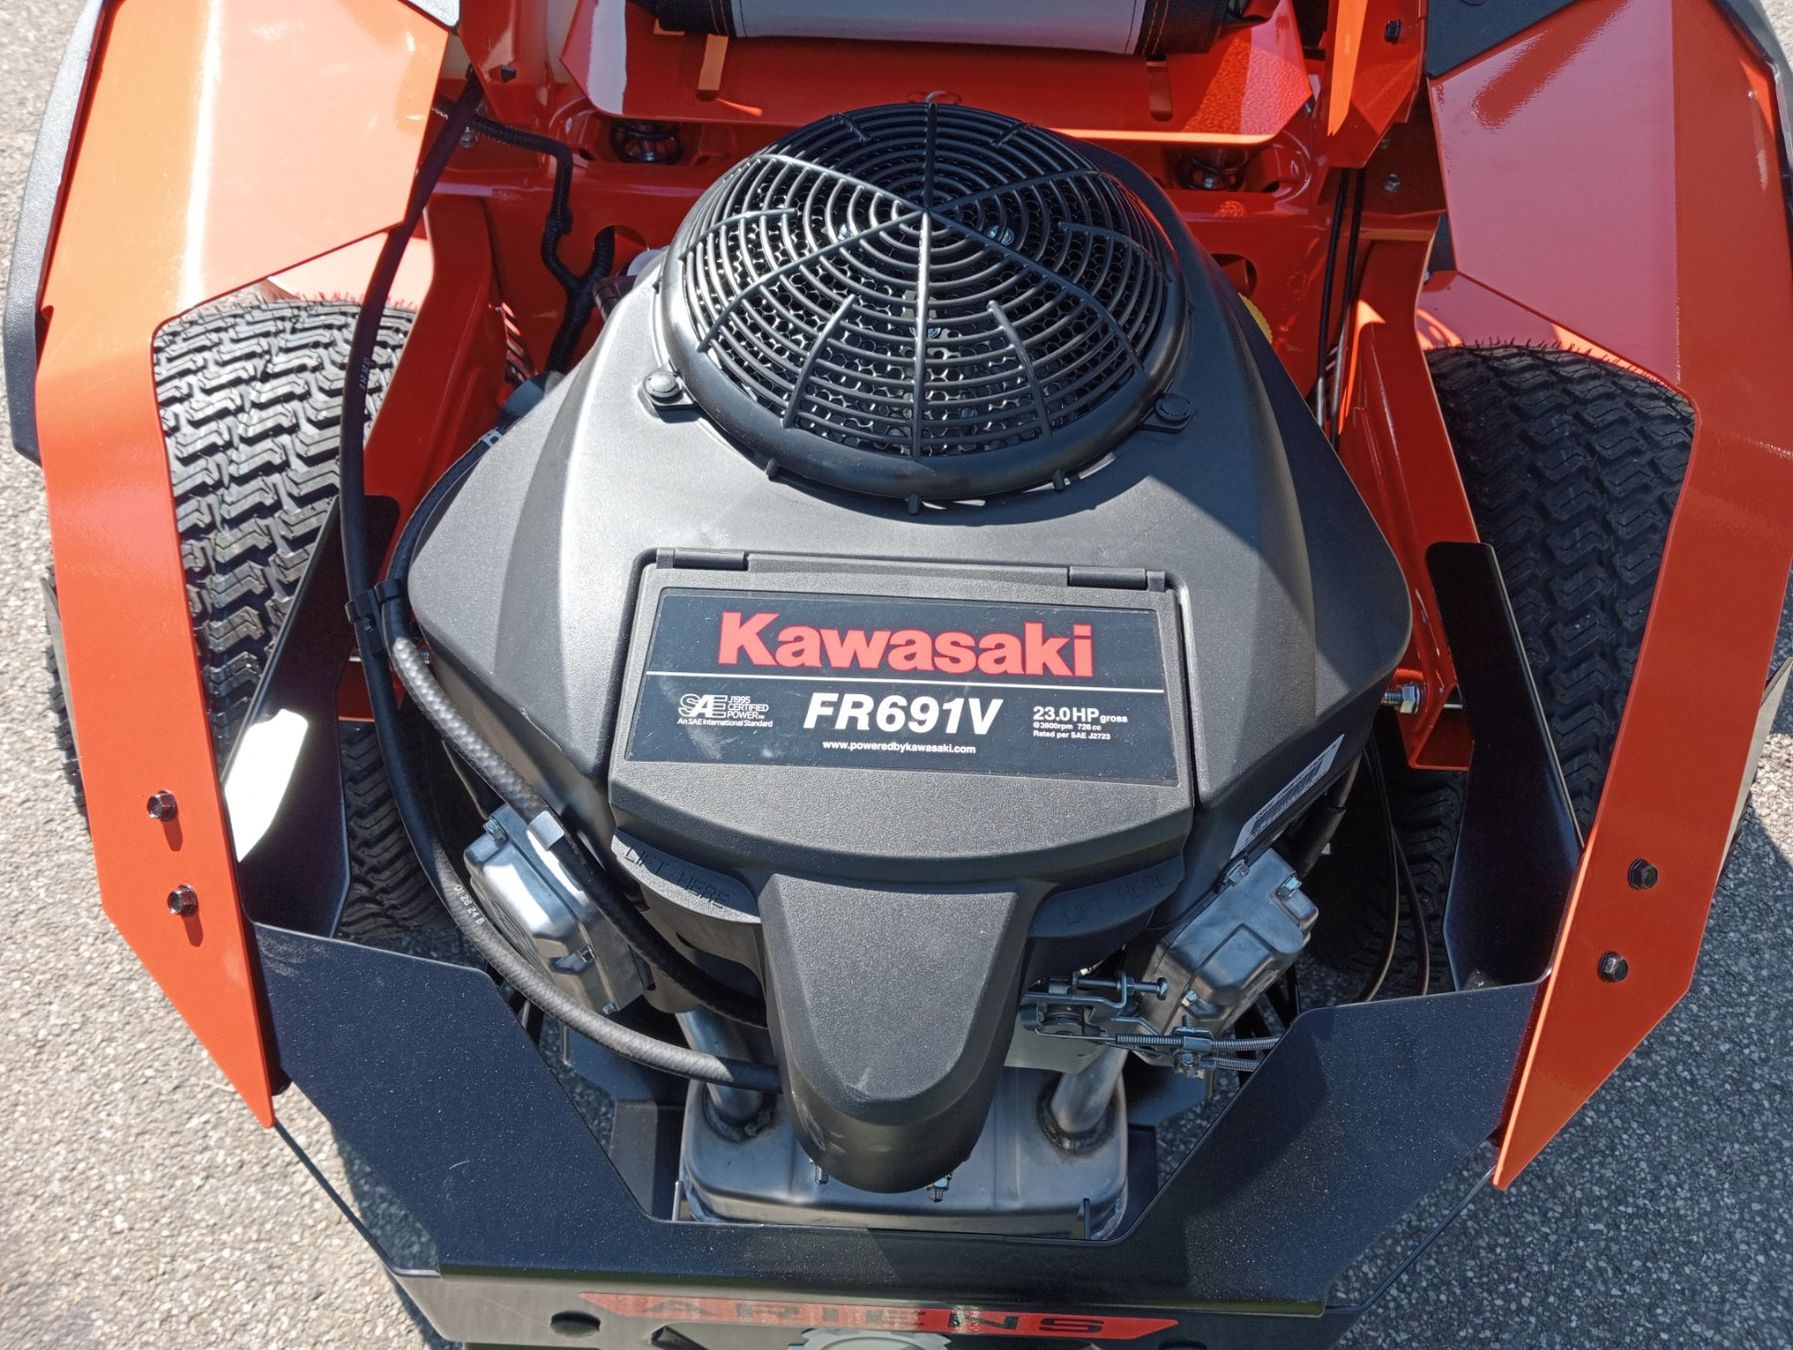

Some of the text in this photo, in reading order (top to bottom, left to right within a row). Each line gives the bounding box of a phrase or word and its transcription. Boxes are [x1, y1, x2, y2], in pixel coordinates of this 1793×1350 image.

[718, 611, 1094, 678] Kawasaki
[678, 693, 728, 719] SAE
[728, 695, 751, 704] J1995
[727, 703, 770, 712] CERTIFIED
[803, 692, 1004, 735] FR691V
[677, 717, 774, 728] An SAE International Standard
[1033, 730, 1055, 738] Rated
[1056, 732, 1069, 740] per
[1088, 733, 1111, 741] J2723
[822, 740, 977, 755] www.poweredbykawasaki.com
[623, 846, 731, 909] LIFT HERE
